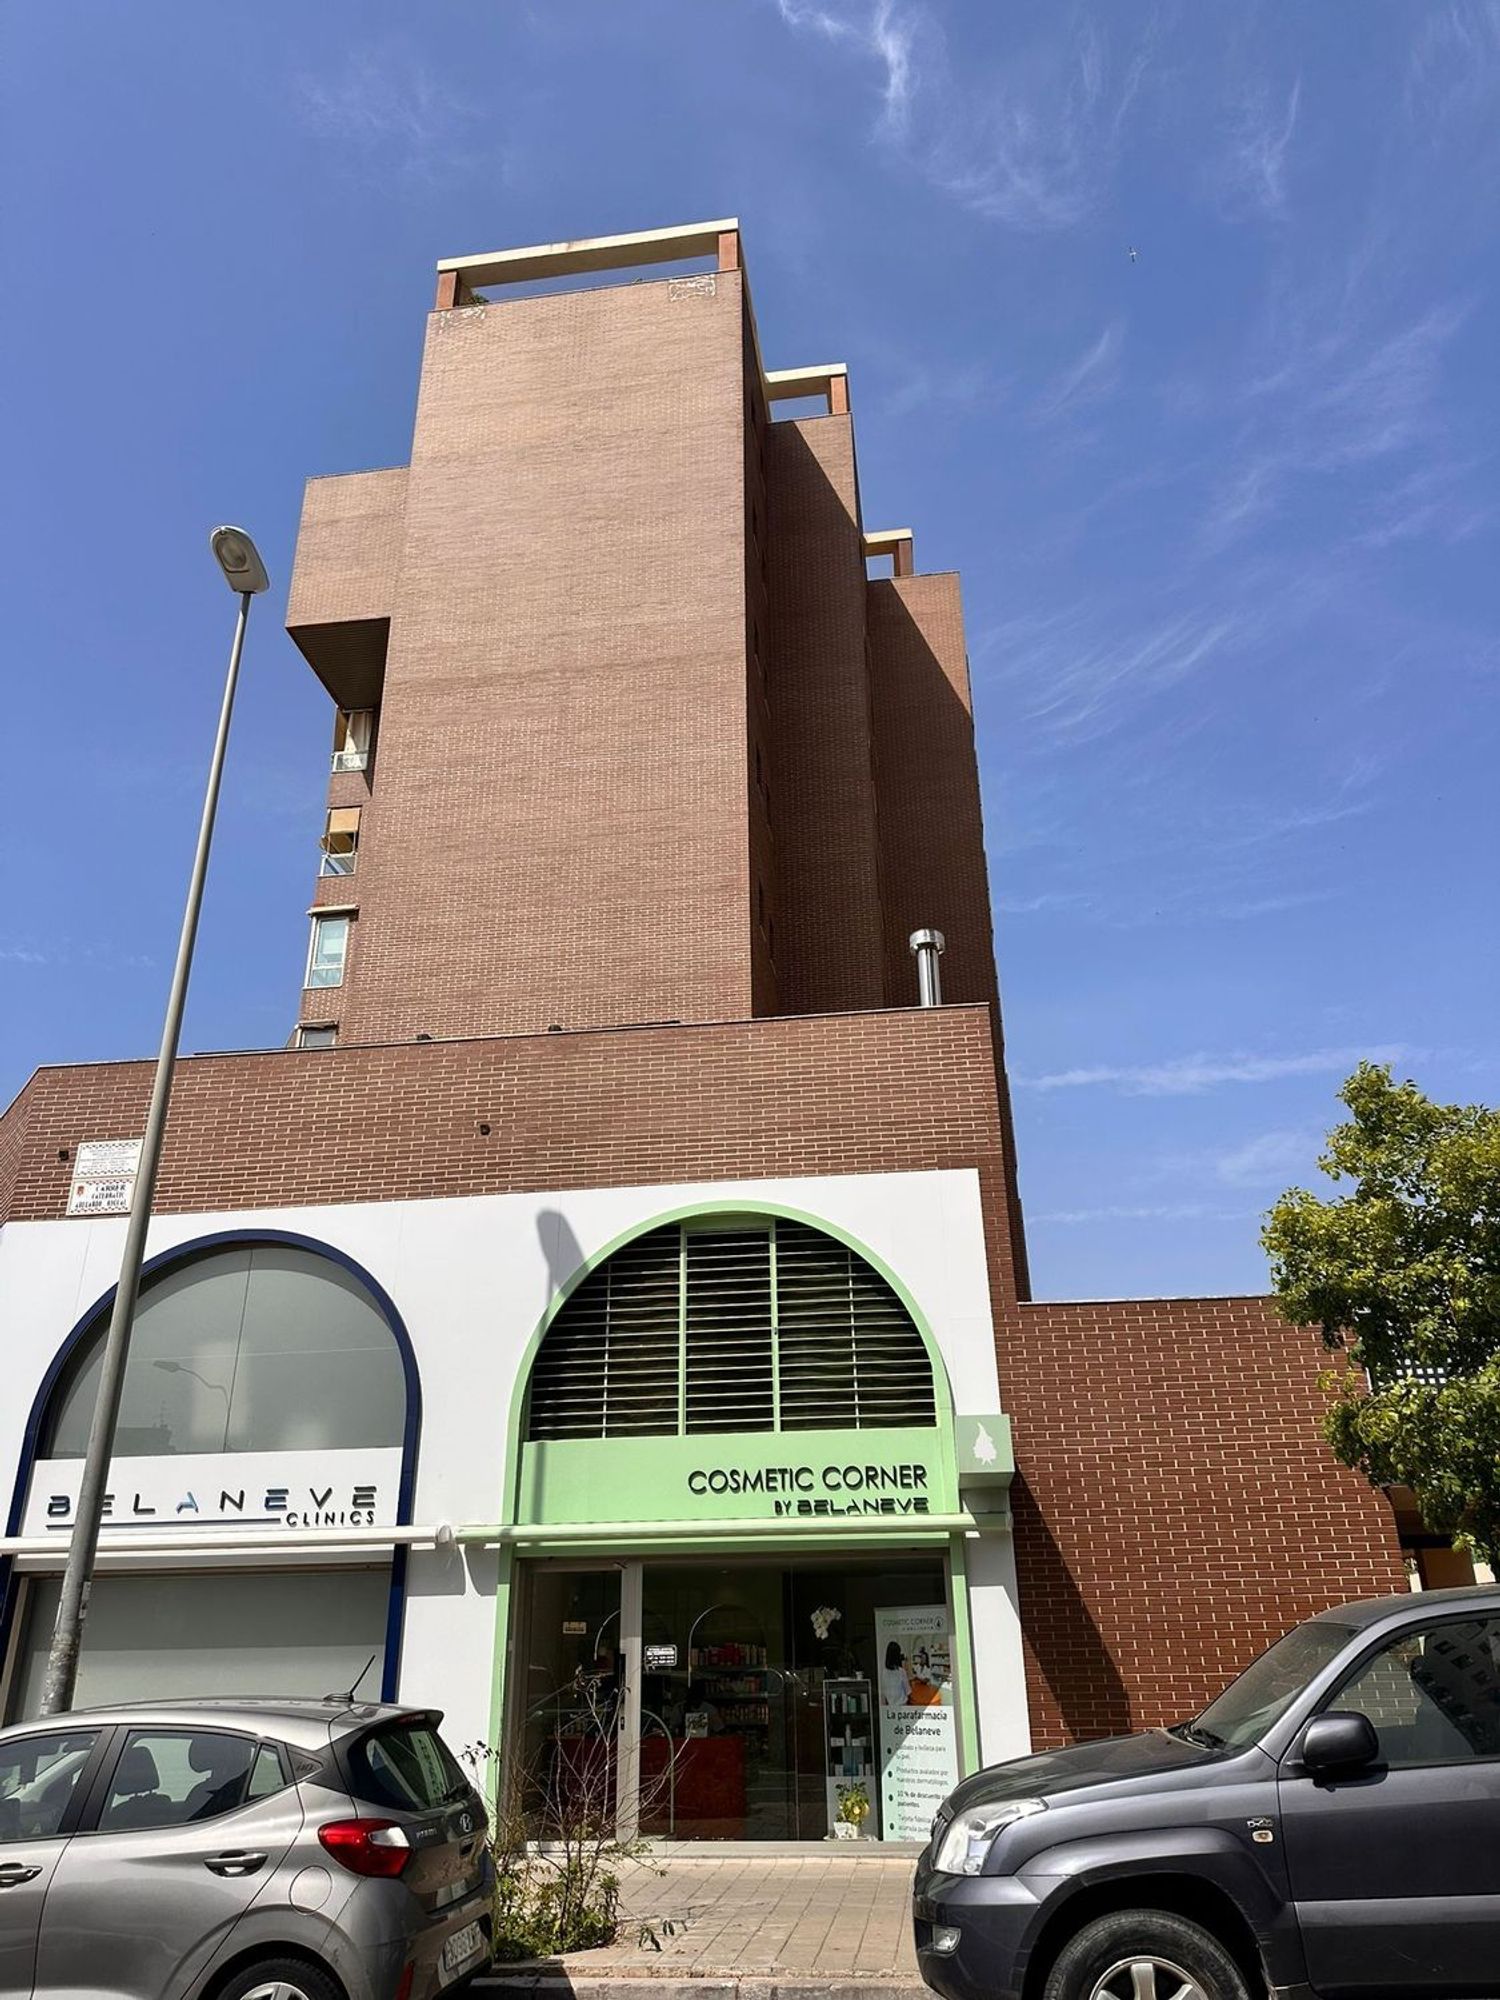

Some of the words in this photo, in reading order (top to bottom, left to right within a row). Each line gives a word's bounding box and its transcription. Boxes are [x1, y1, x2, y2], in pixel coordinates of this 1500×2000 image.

[688, 1466, 814, 1495] COSMETIC
[822, 1465, 929, 1491] CORNER
[47, 1486, 377, 1517] BELANEVE
[774, 1499, 792, 1516] BY
[797, 1497, 930, 1515] BELANEVE
[286, 1510, 376, 1528] CLINICS
[887, 1710, 896, 1720] La
[897, 1710, 948, 1721] parafarmacia
[893, 1725, 904, 1735] de
[905, 1726, 942, 1736] Belaneve
